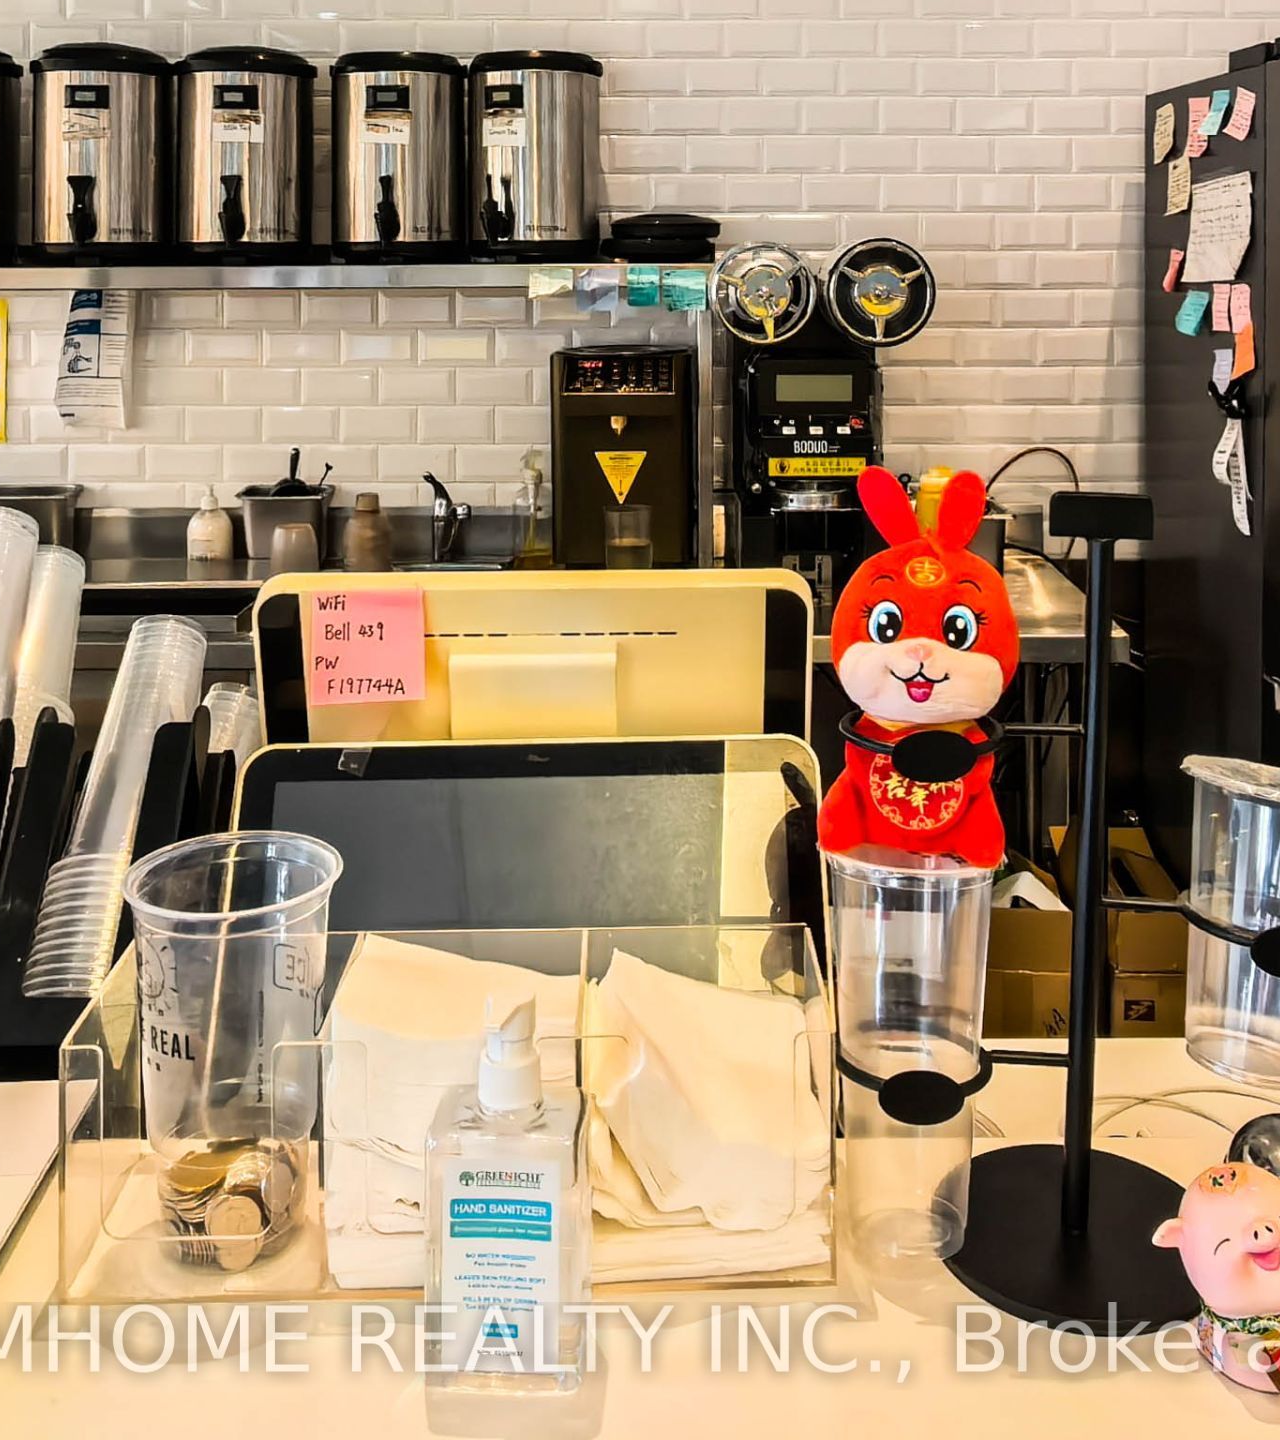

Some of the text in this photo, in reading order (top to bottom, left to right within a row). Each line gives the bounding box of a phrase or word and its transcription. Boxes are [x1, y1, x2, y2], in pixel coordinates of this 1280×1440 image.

[793, 440, 828, 454] BODUO
[317, 594, 347, 611] WiFi
[325, 622, 350, 641] Bell
[315, 656, 339, 671] PW
[150, 1025, 196, 1061] REAL
[454, 1203, 547, 1217] HAND SANITIZER
